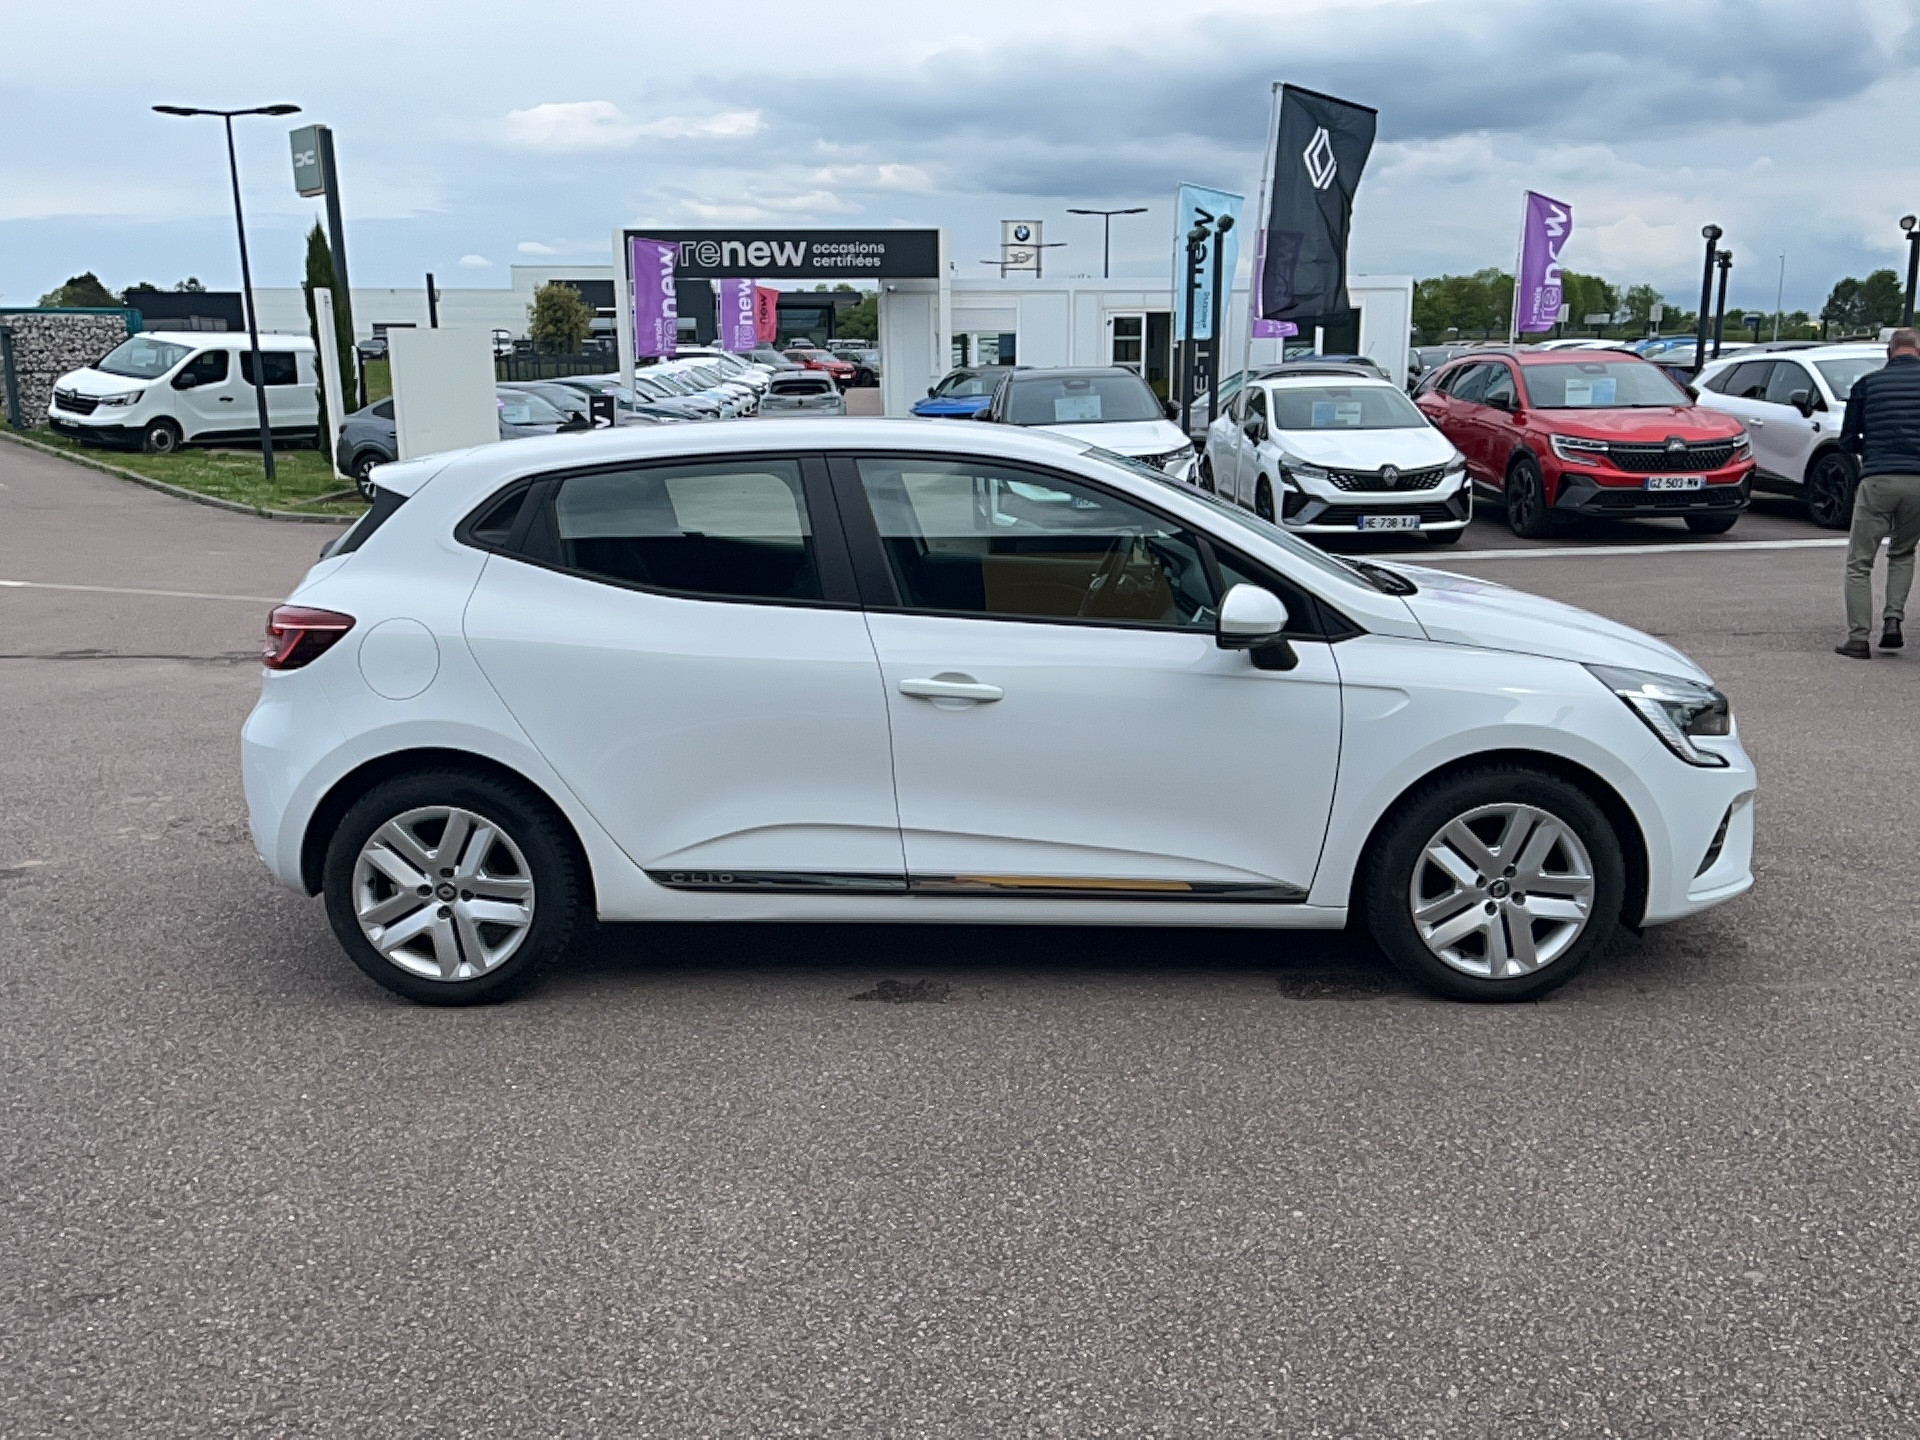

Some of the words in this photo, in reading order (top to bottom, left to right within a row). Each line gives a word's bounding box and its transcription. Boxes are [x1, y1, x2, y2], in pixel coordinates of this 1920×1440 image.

[679, 240, 807, 267] renew
[812, 241, 885, 254] occasions
[812, 254, 881, 267] certifiées
[657, 245, 678, 352] renew
[670, 872, 734, 883] CLIO
